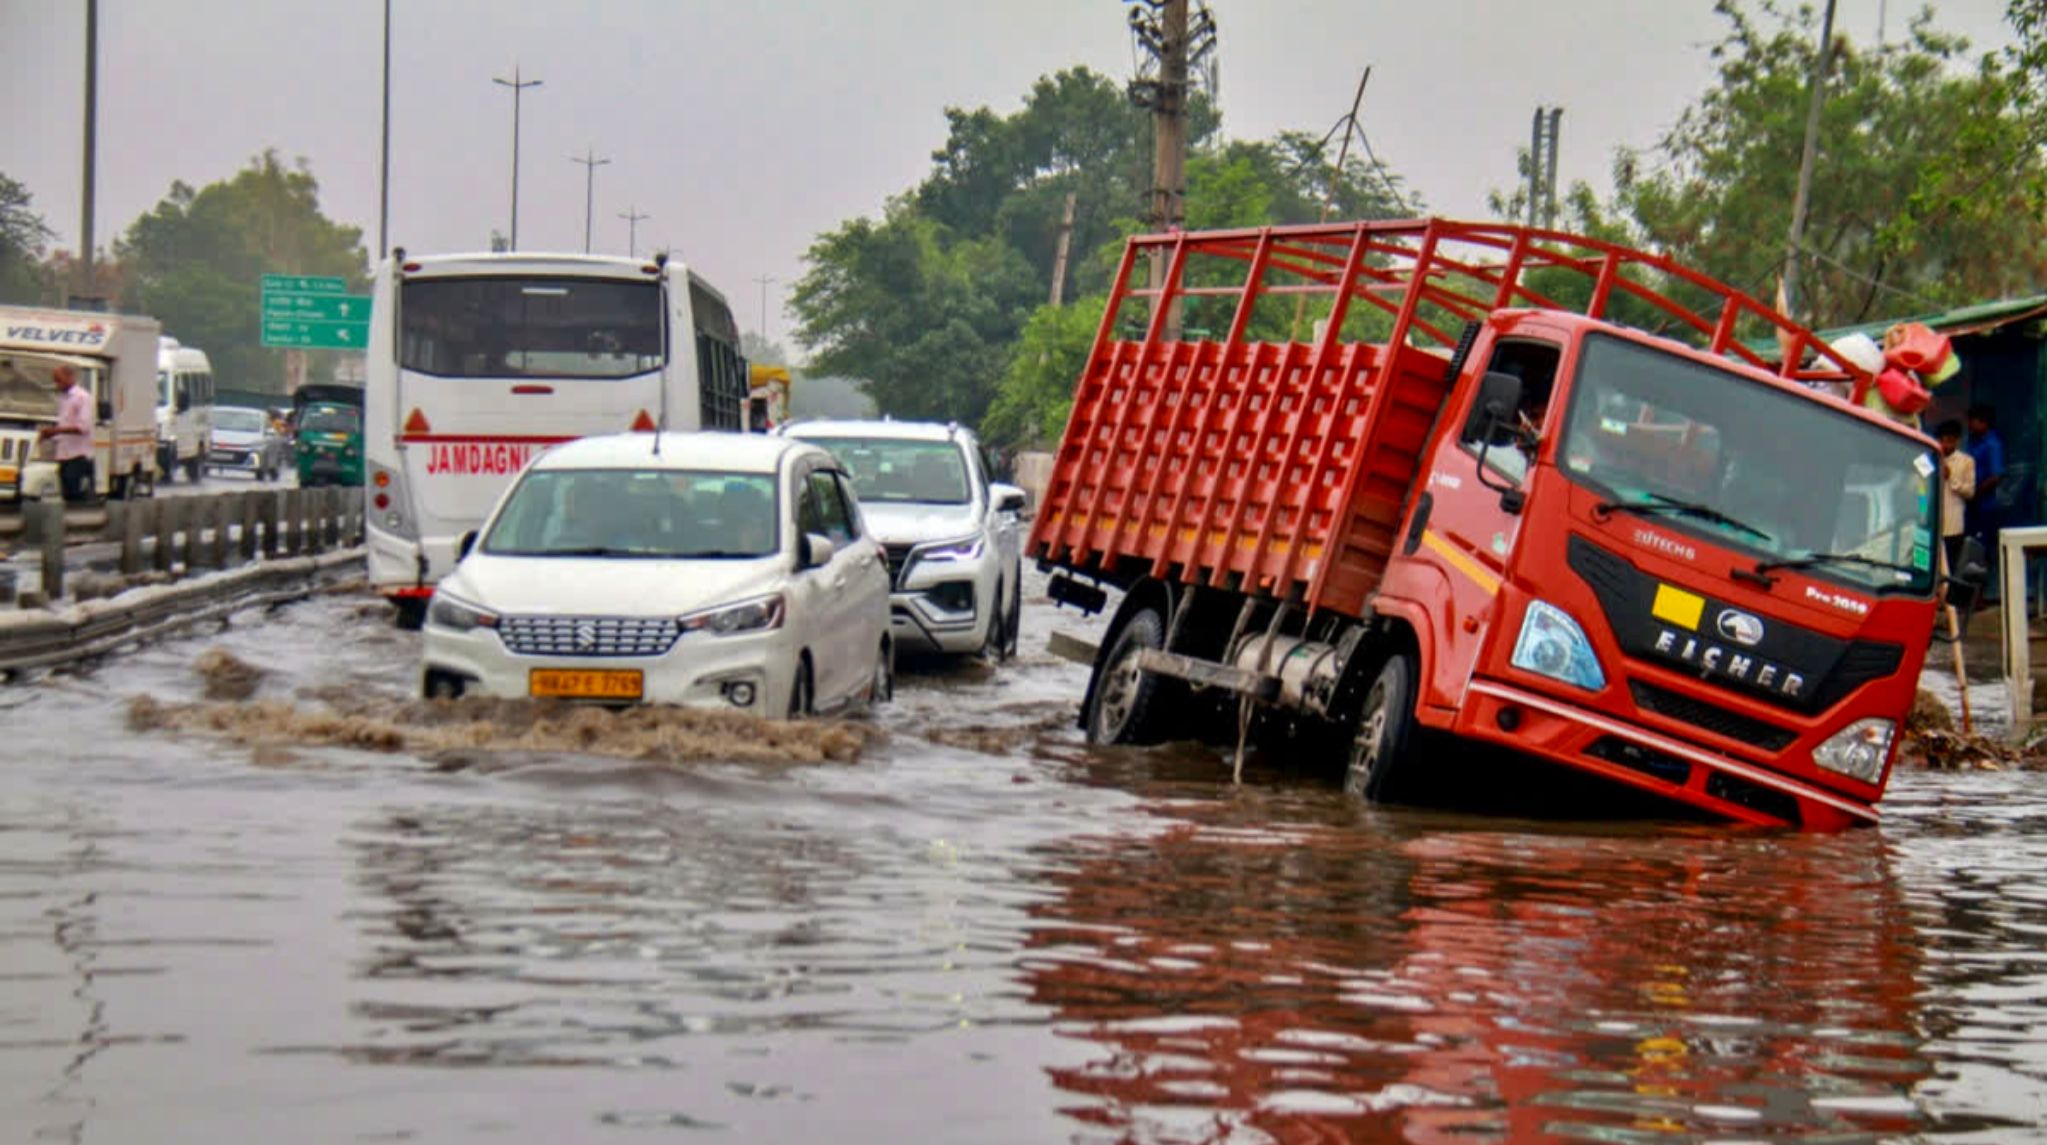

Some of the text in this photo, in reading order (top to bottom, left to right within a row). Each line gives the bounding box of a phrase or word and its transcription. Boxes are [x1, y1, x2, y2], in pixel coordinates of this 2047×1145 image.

[7, 326, 104, 344] VELVETS
[1806, 586, 1831, 603] Pro
[1655, 629, 1805, 697] EICHER
